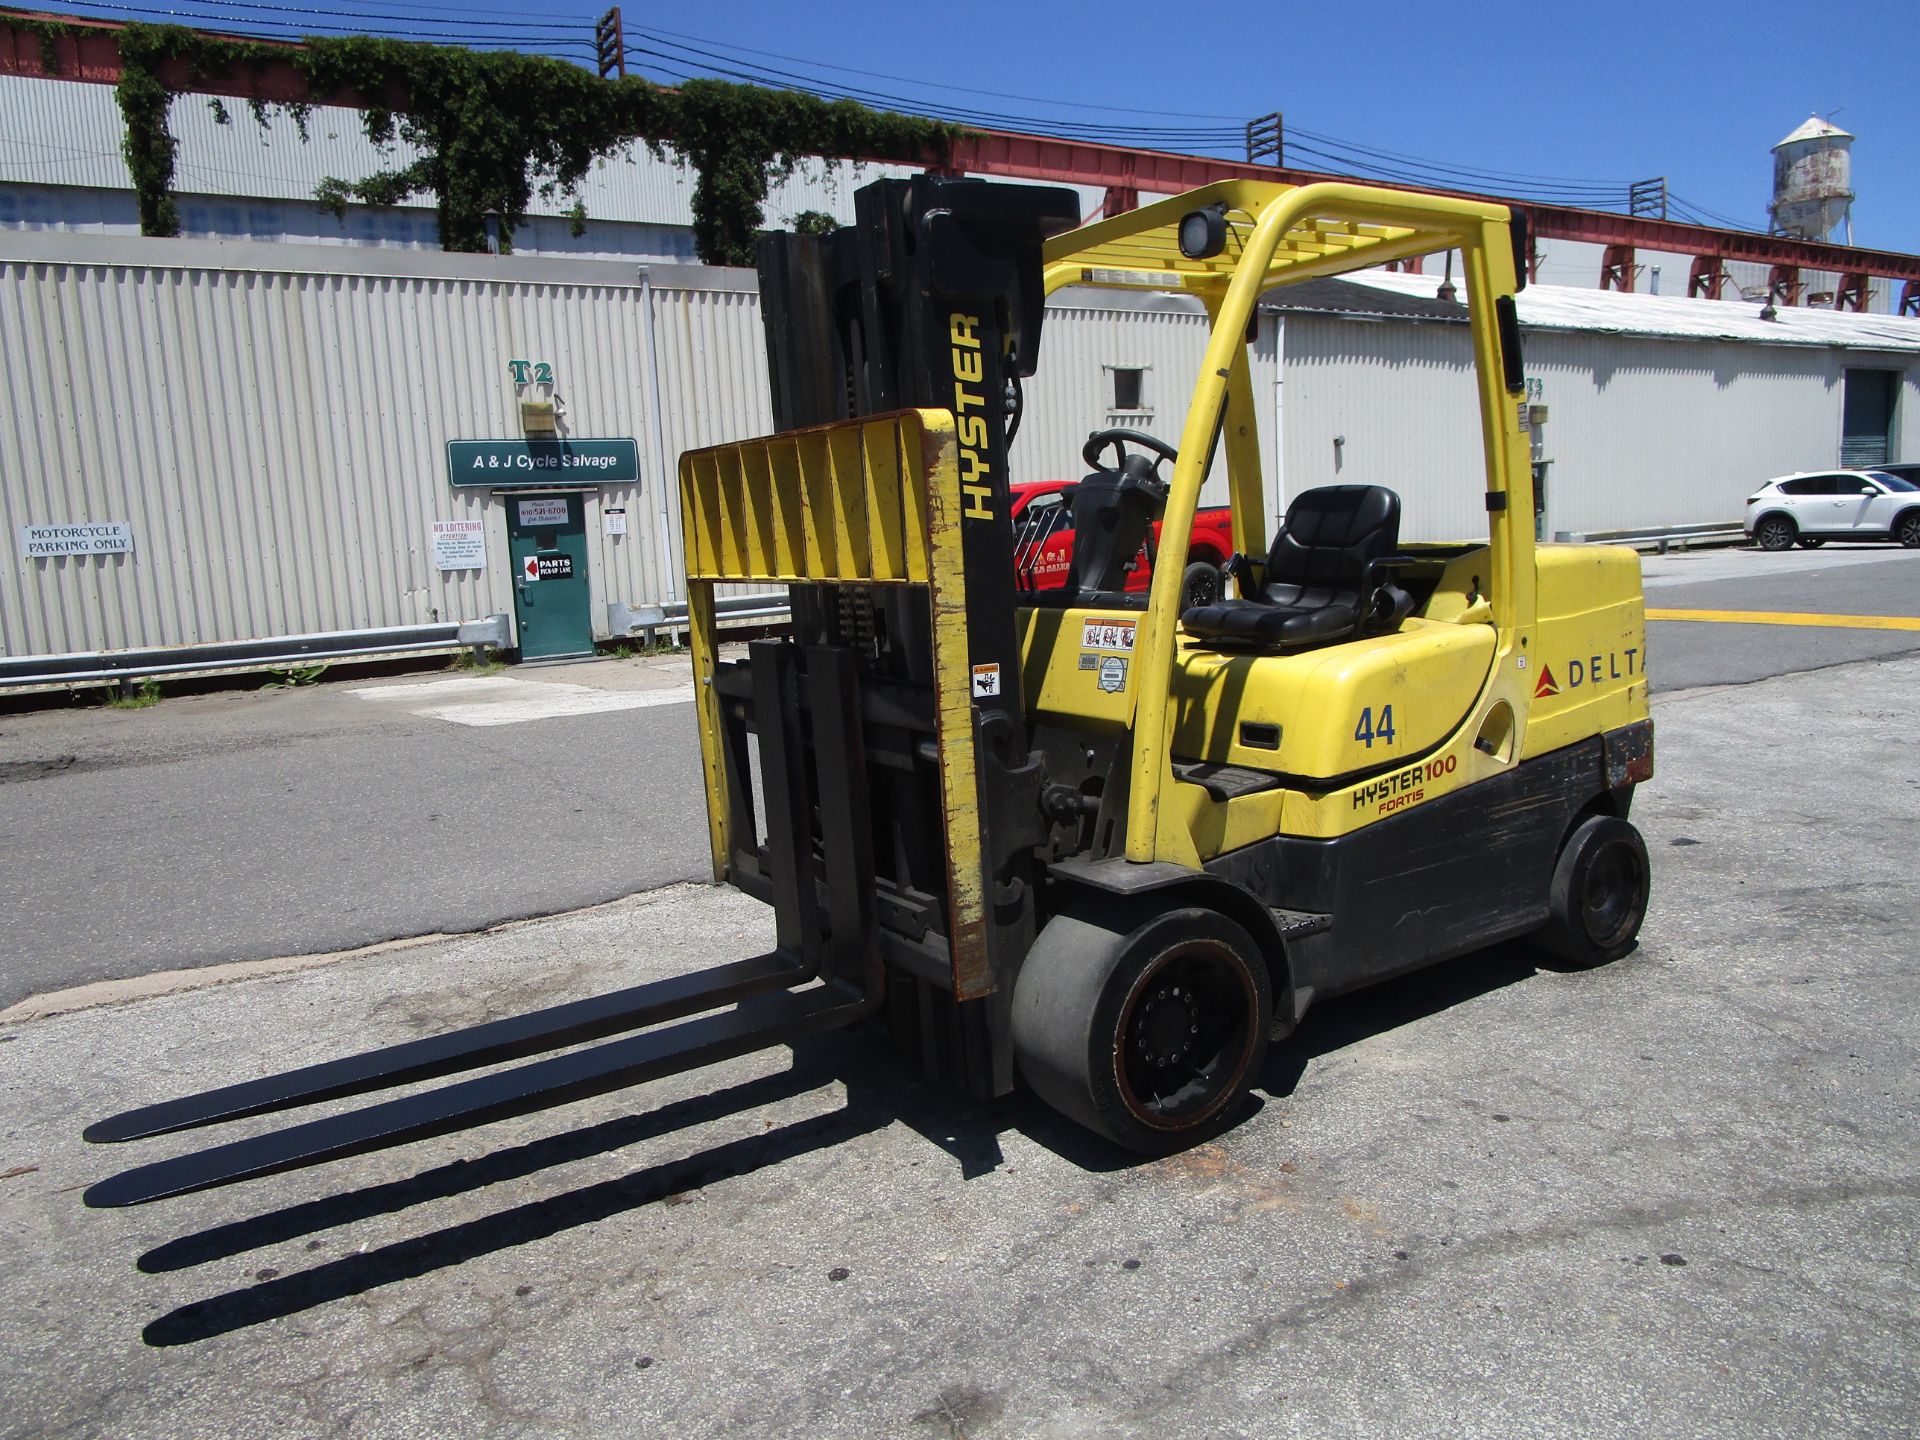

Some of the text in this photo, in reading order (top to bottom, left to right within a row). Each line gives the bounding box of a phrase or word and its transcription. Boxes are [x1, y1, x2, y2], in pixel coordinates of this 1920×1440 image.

[1526, 378, 1543, 392] T3
[950, 313, 994, 520] HYSTER
[472, 454, 617, 471] A & J Cycle Salvage
[31, 526, 121, 539] MOTORCYCLE
[433, 522, 482, 532] NO LOITERING
[29, 539, 127, 553] PARKING ONLY
[1047, 552, 1056, 562] &
[1057, 549, 1066, 562] J
[540, 559, 571, 568] PARTS
[540, 567, 559, 575] PICK-UP
[1355, 704, 1396, 748] 44
[1353, 754, 1457, 810] HYSTER 100
[1378, 788, 1424, 815] FORTIS
